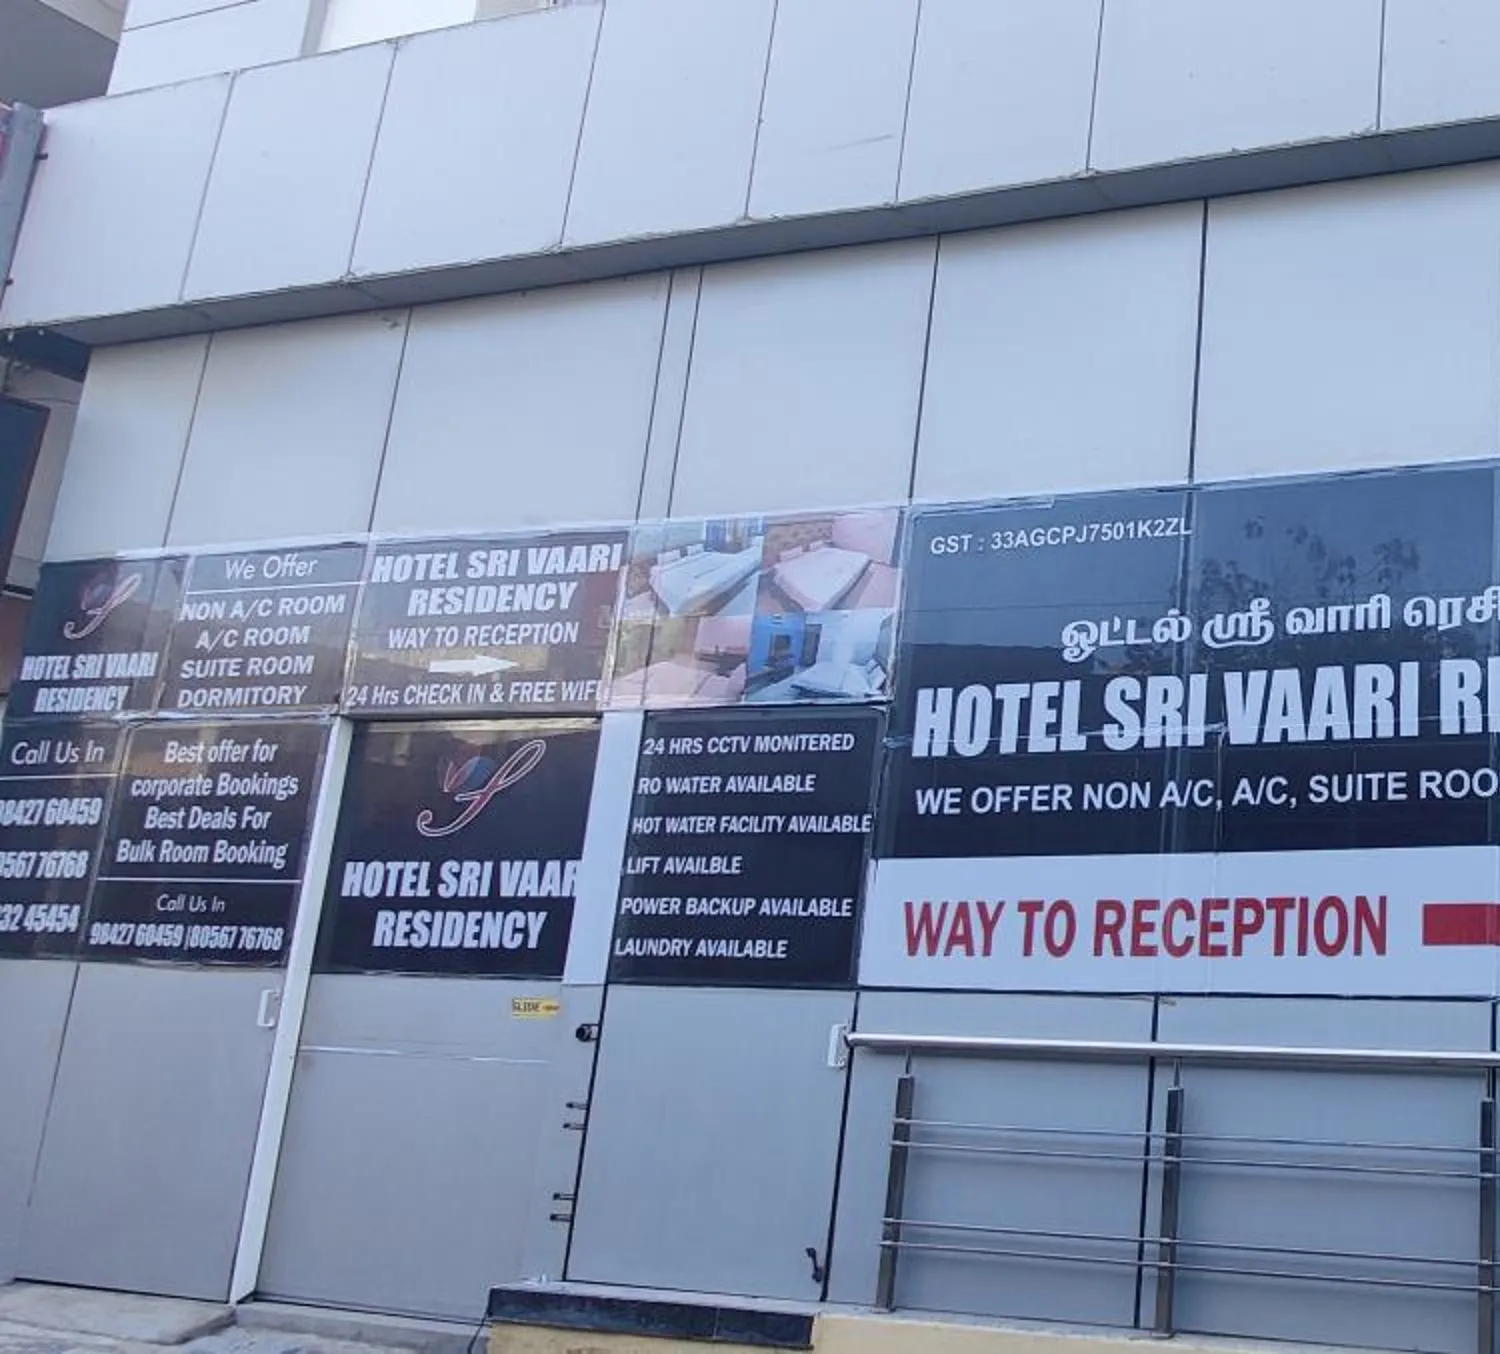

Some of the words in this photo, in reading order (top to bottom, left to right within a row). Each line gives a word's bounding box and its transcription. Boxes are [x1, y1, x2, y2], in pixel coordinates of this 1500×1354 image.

[930, 535, 972, 555] GST
[991, 518, 1193, 549] 33AGCPJ7501K2ZL
[225, 559, 256, 580] We
[263, 553, 318, 578] Offer
[371, 552, 459, 583] HOTEL
[466, 550, 520, 579] SRI
[527, 544, 623, 576] VAARI
[179, 601, 225, 620] NON
[230, 599, 273, 622] A/C
[278, 594, 346, 616] ROOM
[407, 582, 578, 616] RESIDENCY
[195, 629, 239, 653] A/C
[243, 625, 311, 646] ROOM
[389, 627, 431, 649] WAY
[435, 626, 459, 647] TO
[464, 621, 579, 647] RECEPTION
[1061, 608, 1192, 663] ஓட்டல்
[1285, 593, 1391, 636] வாரி
[20, 656, 71, 680] HOTEL
[72, 653, 103, 679] SRI
[105, 652, 158, 678] VAARI
[180, 658, 242, 679] SUITE
[246, 655, 315, 676] ROOM
[34, 685, 129, 712] RESIDENCY
[177, 685, 307, 708] DORMITORY
[347, 686, 369, 706] 24
[371, 686, 399, 705] Hrs
[404, 684, 463, 705] CHECK
[467, 684, 484, 703] IN
[490, 684, 505, 702] &
[509, 680, 558, 703] FREE
[912, 680, 1087, 758] HOTEL
[1102, 673, 1209, 751] SRI
[1223, 661, 1420, 745] VAARI
[11, 740, 50, 766] Call
[55, 741, 80, 764] Us
[85, 740, 104, 763] In
[164, 740, 204, 763] Best
[208, 739, 250, 763] offer
[251, 738, 279, 762] for
[642, 738, 666, 755] 24
[669, 737, 703, 755] HRS
[707, 736, 751, 754] CCTV
[754, 734, 855, 753] MONITERED
[131, 775, 213, 800] corporate
[216, 772, 299, 801] Bookings
[637, 777, 662, 795] RO
[665, 776, 722, 794] WATER
[725, 774, 817, 793] AVAILABLE
[915, 787, 963, 816] WE
[971, 782, 1073, 815] OFFER
[1082, 780, 1152, 811] NON
[1159, 778, 1224, 811] A/C,
[1231, 776, 1298, 809] A/C,
[1308, 771, 1408, 803] SUITE
[44, 797, 102, 826] 60459
[144, 806, 186, 829] Best
[188, 806, 237, 830] Deals
[241, 806, 272, 830] For
[631, 817, 662, 834] HOT
[664, 816, 716, 833] WATER
[719, 815, 786, 833] FACILITY
[788, 814, 872, 833] AVAILABLE
[36, 850, 89, 879] 76768
[116, 838, 156, 862] Bulk
[159, 839, 209, 863] Room
[213, 839, 288, 869] Booking
[626, 856, 662, 874] LIFT
[663, 855, 743, 874] AVAILBLE
[341, 861, 431, 897] HOTEL
[437, 860, 494, 897] SRI
[23, 903, 81, 933] 45454
[620, 897, 681, 915] POWER
[685, 898, 756, 916] BACKUP
[759, 898, 853, 917] AVAILABLE
[373, 909, 548, 949] RESIDENCY
[904, 899, 1006, 958] WAY
[1018, 899, 1077, 958] TO
[1093, 895, 1388, 958] RECEPTION
[614, 938, 692, 956] LAUNDRY
[695, 939, 788, 958] AVAILABLE
